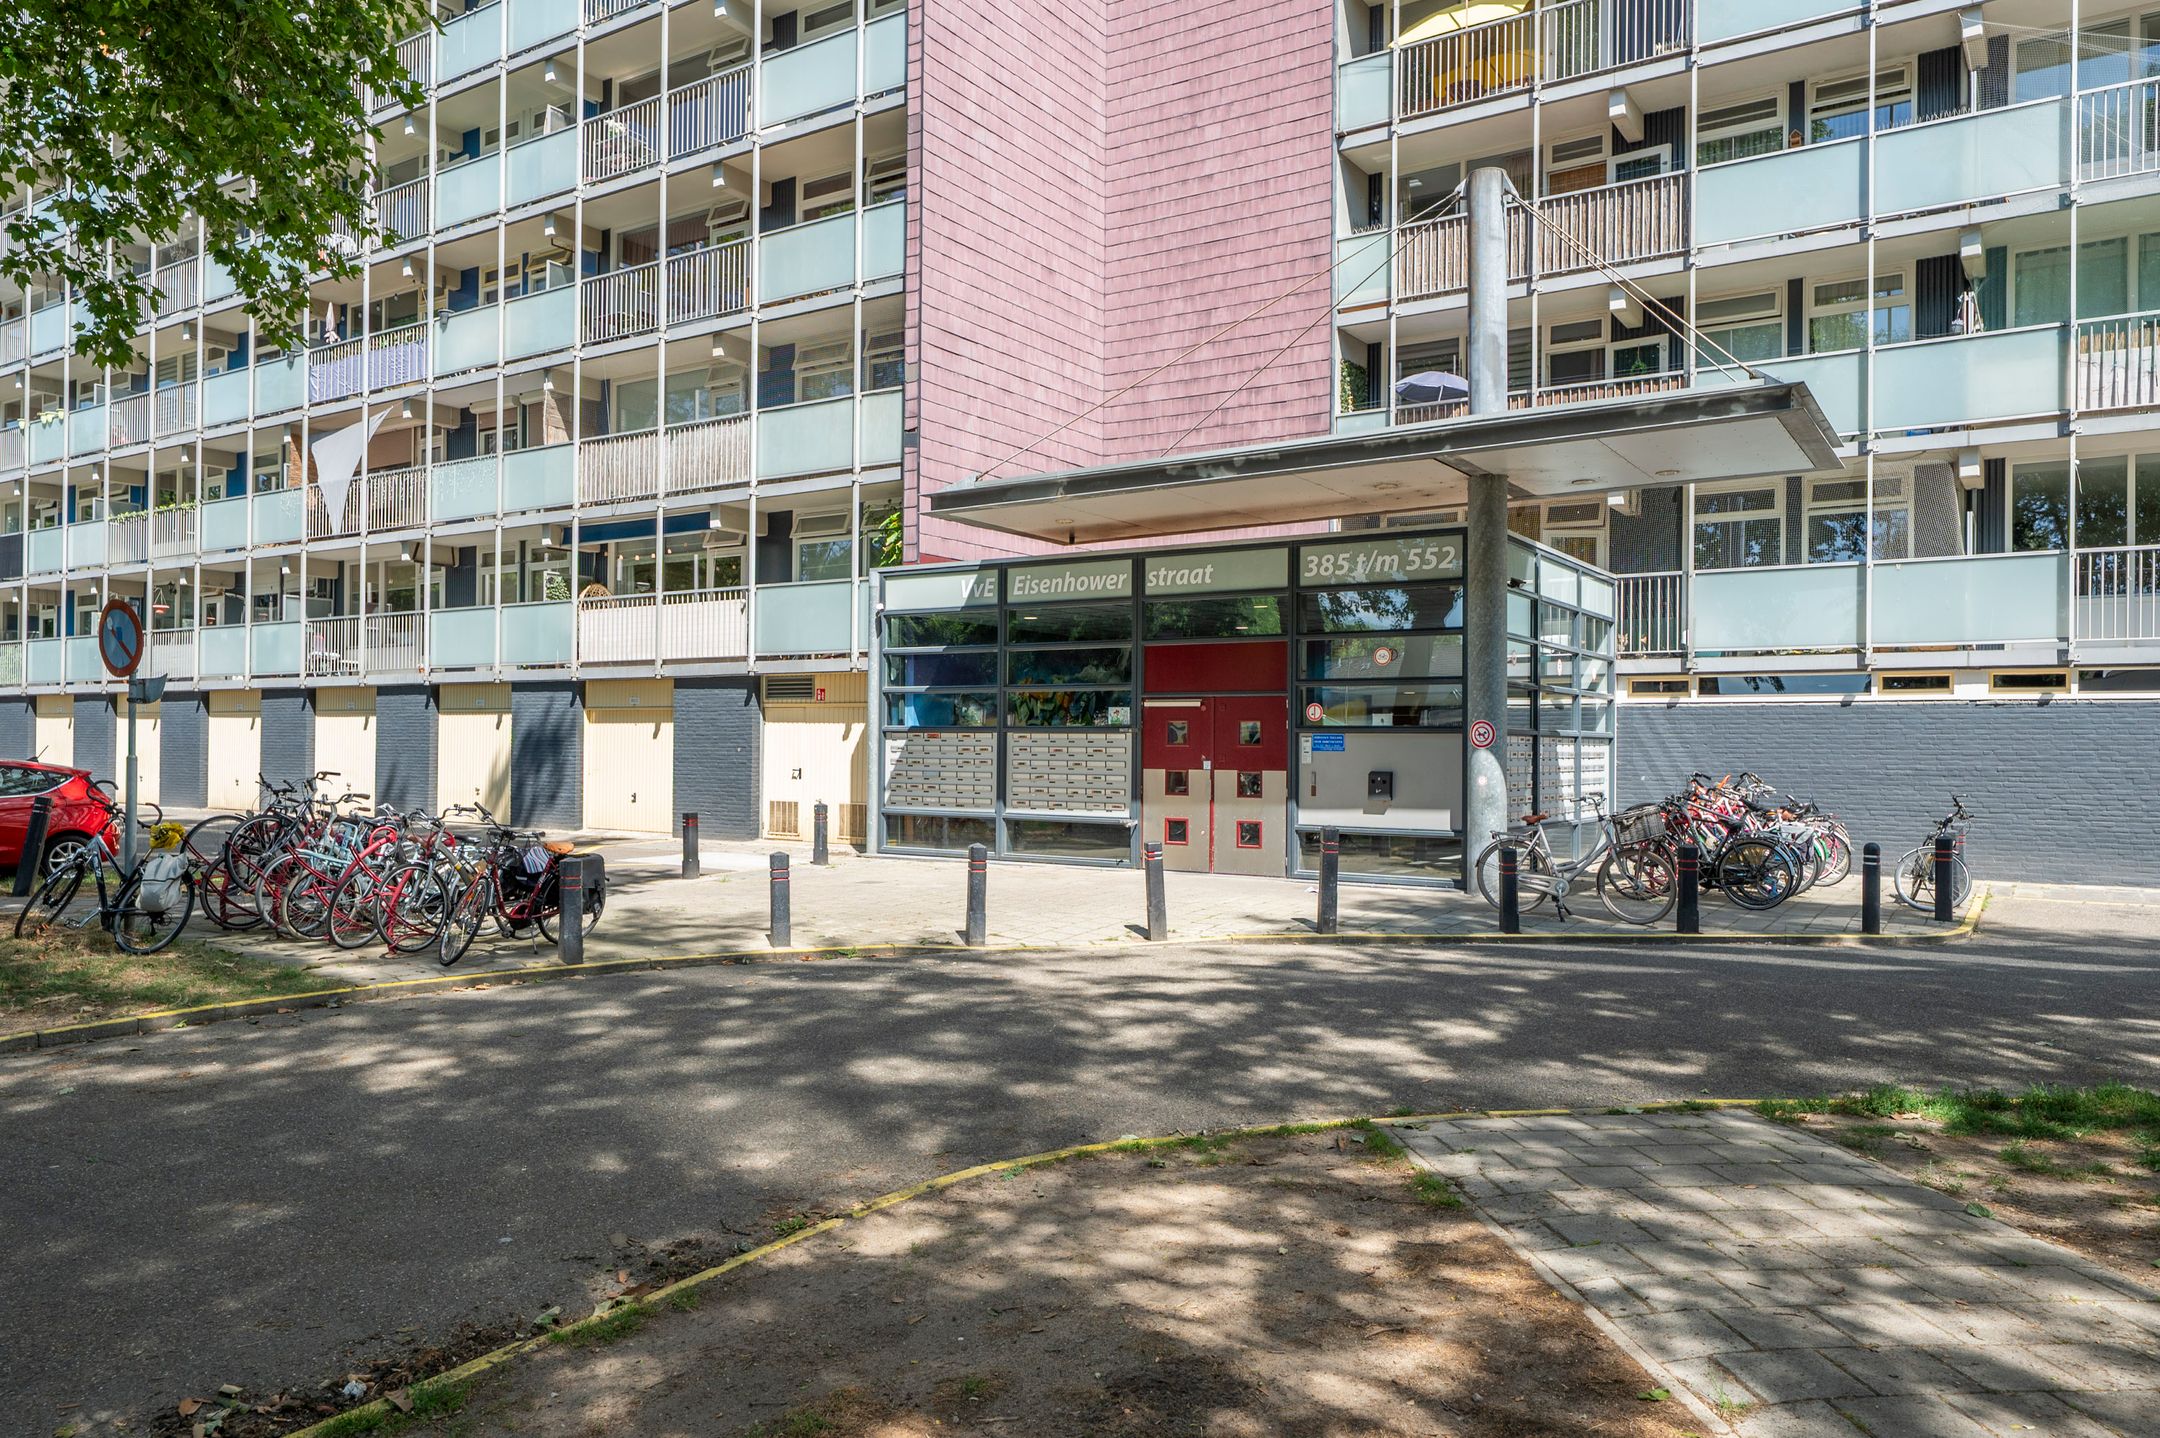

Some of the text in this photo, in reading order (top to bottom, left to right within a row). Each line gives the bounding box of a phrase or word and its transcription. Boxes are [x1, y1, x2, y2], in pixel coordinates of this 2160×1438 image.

[960, 545, 1456, 598] VvE Eisenhower straat 385 t/m 552
